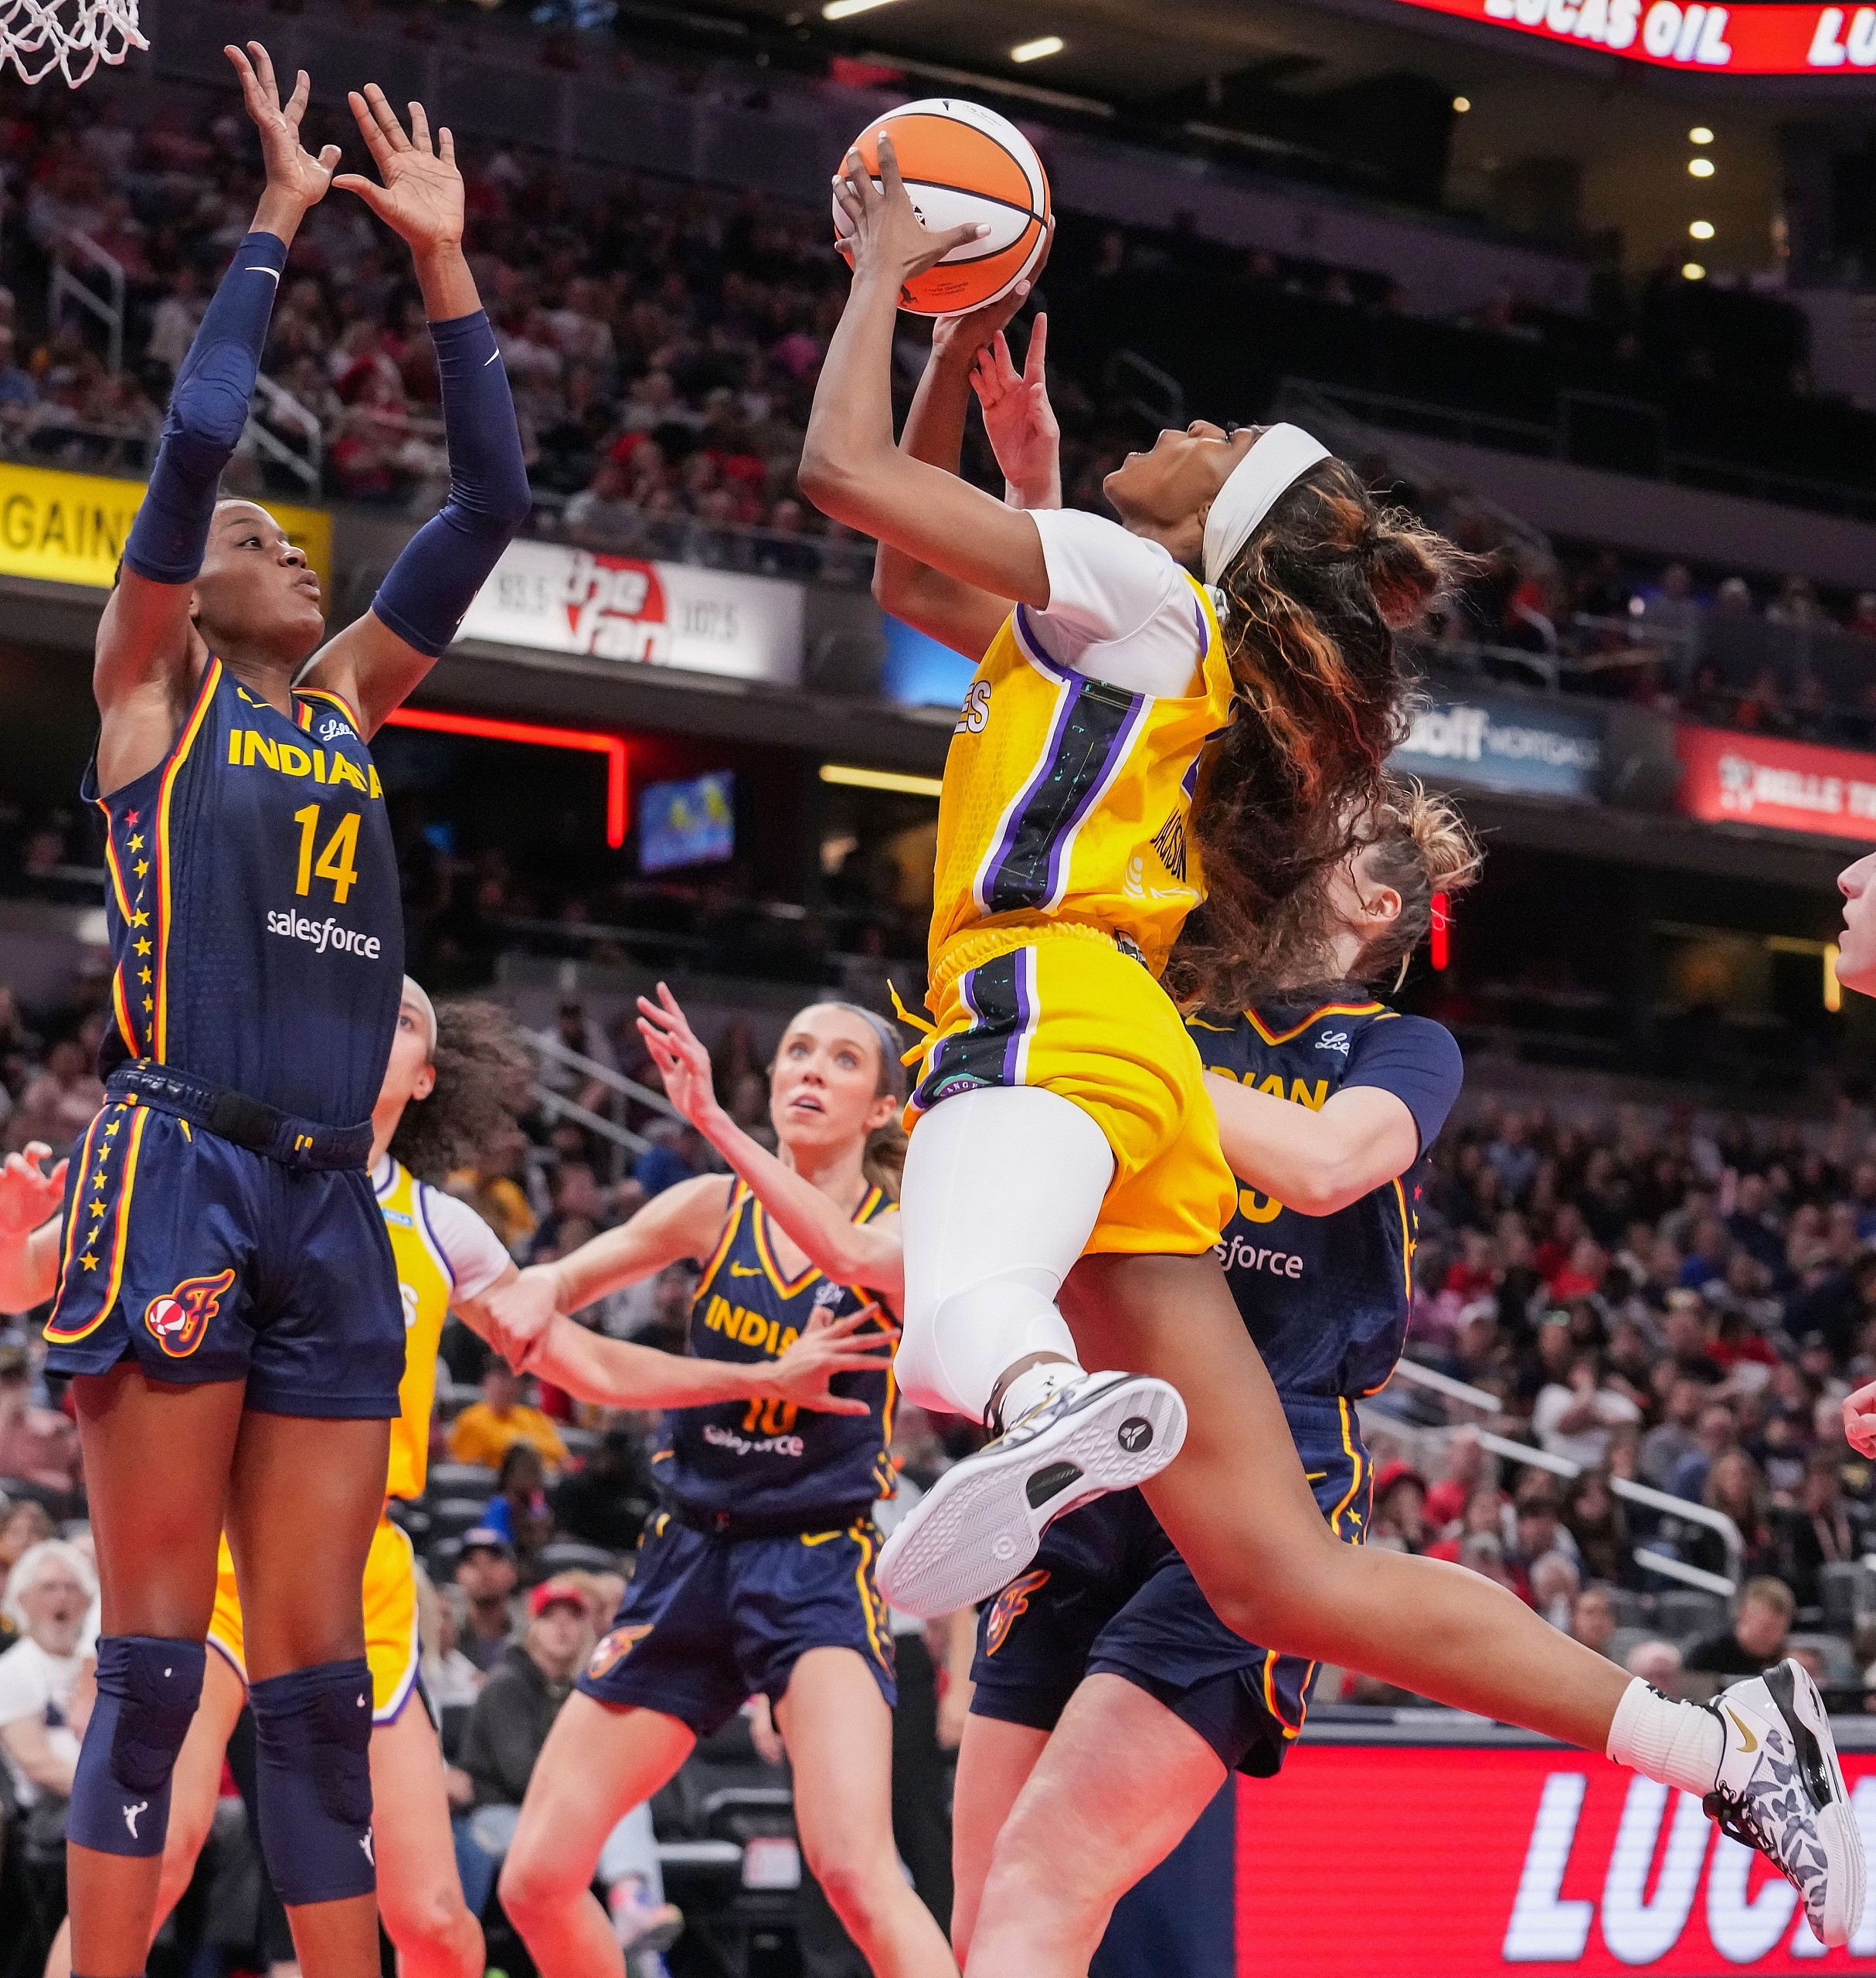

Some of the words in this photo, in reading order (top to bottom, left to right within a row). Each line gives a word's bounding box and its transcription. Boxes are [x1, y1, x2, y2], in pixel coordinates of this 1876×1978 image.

[1483, 0, 1643, 49] UCAS
[1643, 0, 1733, 65] OIL
[294, 803, 362, 904] 14
[267, 908, 382, 960] salesforce
